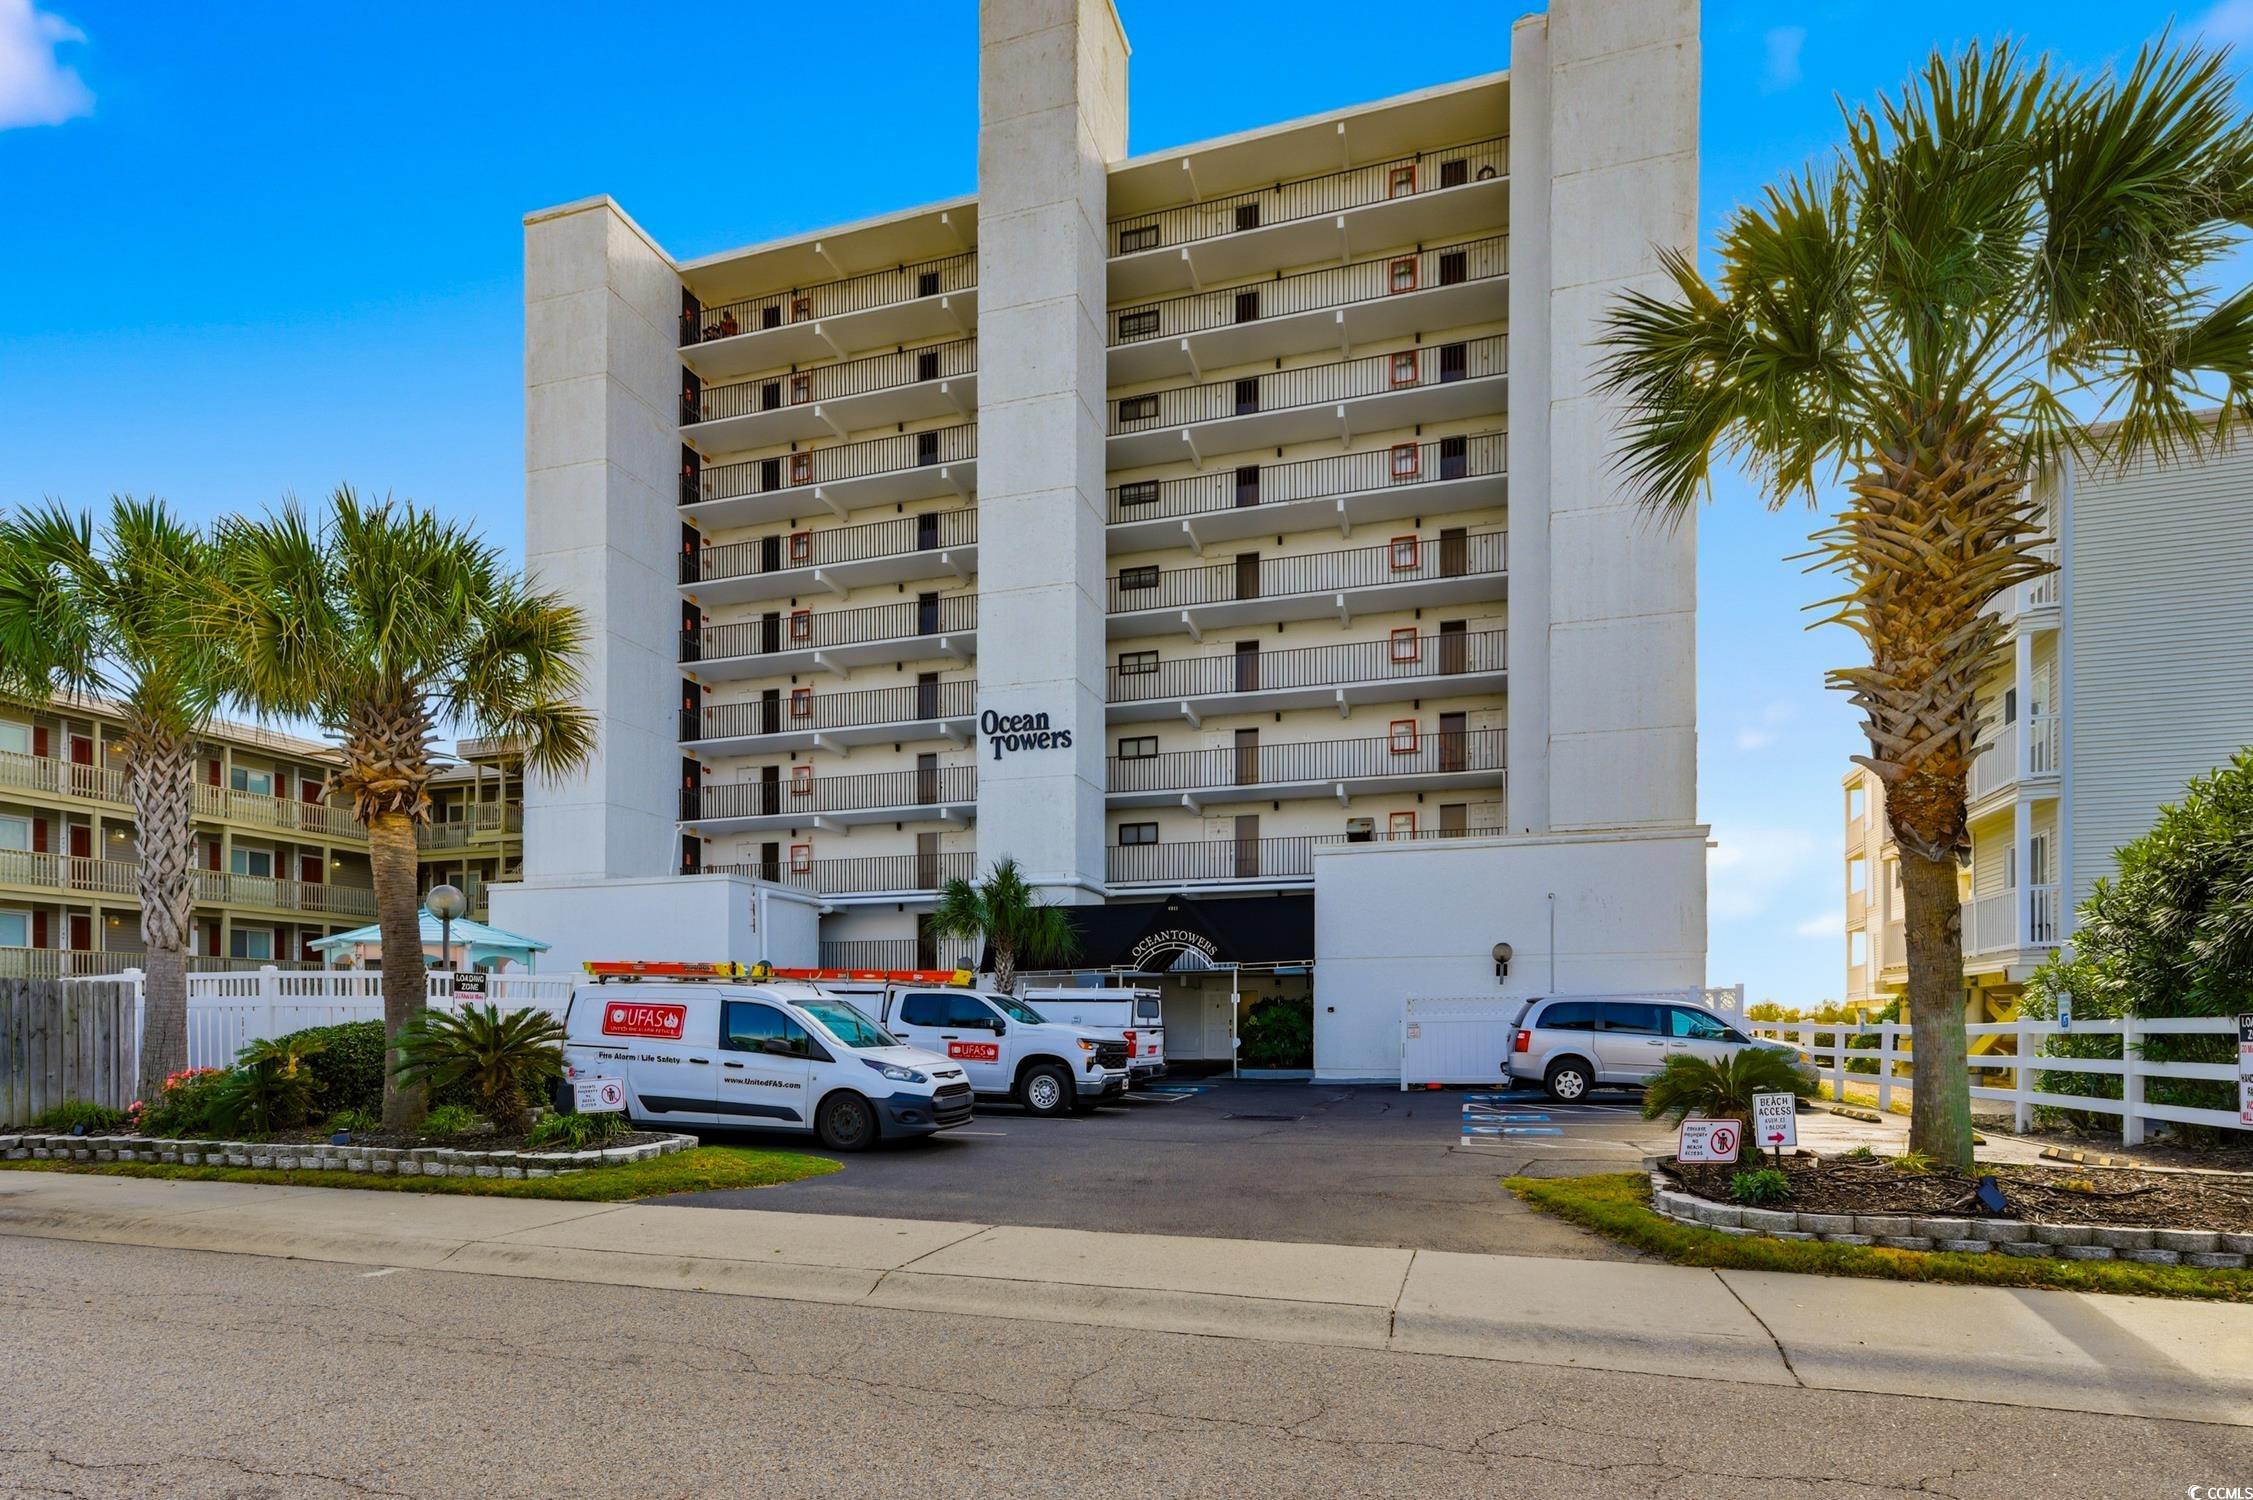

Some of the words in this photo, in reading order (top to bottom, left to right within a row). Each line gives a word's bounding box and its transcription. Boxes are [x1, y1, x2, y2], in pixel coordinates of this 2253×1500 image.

[981, 709, 1050, 735] Ocean
[990, 729, 1072, 760] Towers
[455, 974, 485, 983] LOADING
[461, 982, 479, 991] ZONE
[628, 1008, 664, 1028] UFAS
[962, 1045, 985, 1055] UFAS
[598, 1051, 613, 1059] Fire
[614, 1052, 636, 1061] Alarm
[641, 1054, 655, 1062] Life
[656, 1055, 681, 1065] Safety
[724, 1077, 801, 1089] www.UnitedFAS.com
[1759, 1096, 1788, 1107] BEACH
[1758, 1106, 1792, 1116] ACCESS
